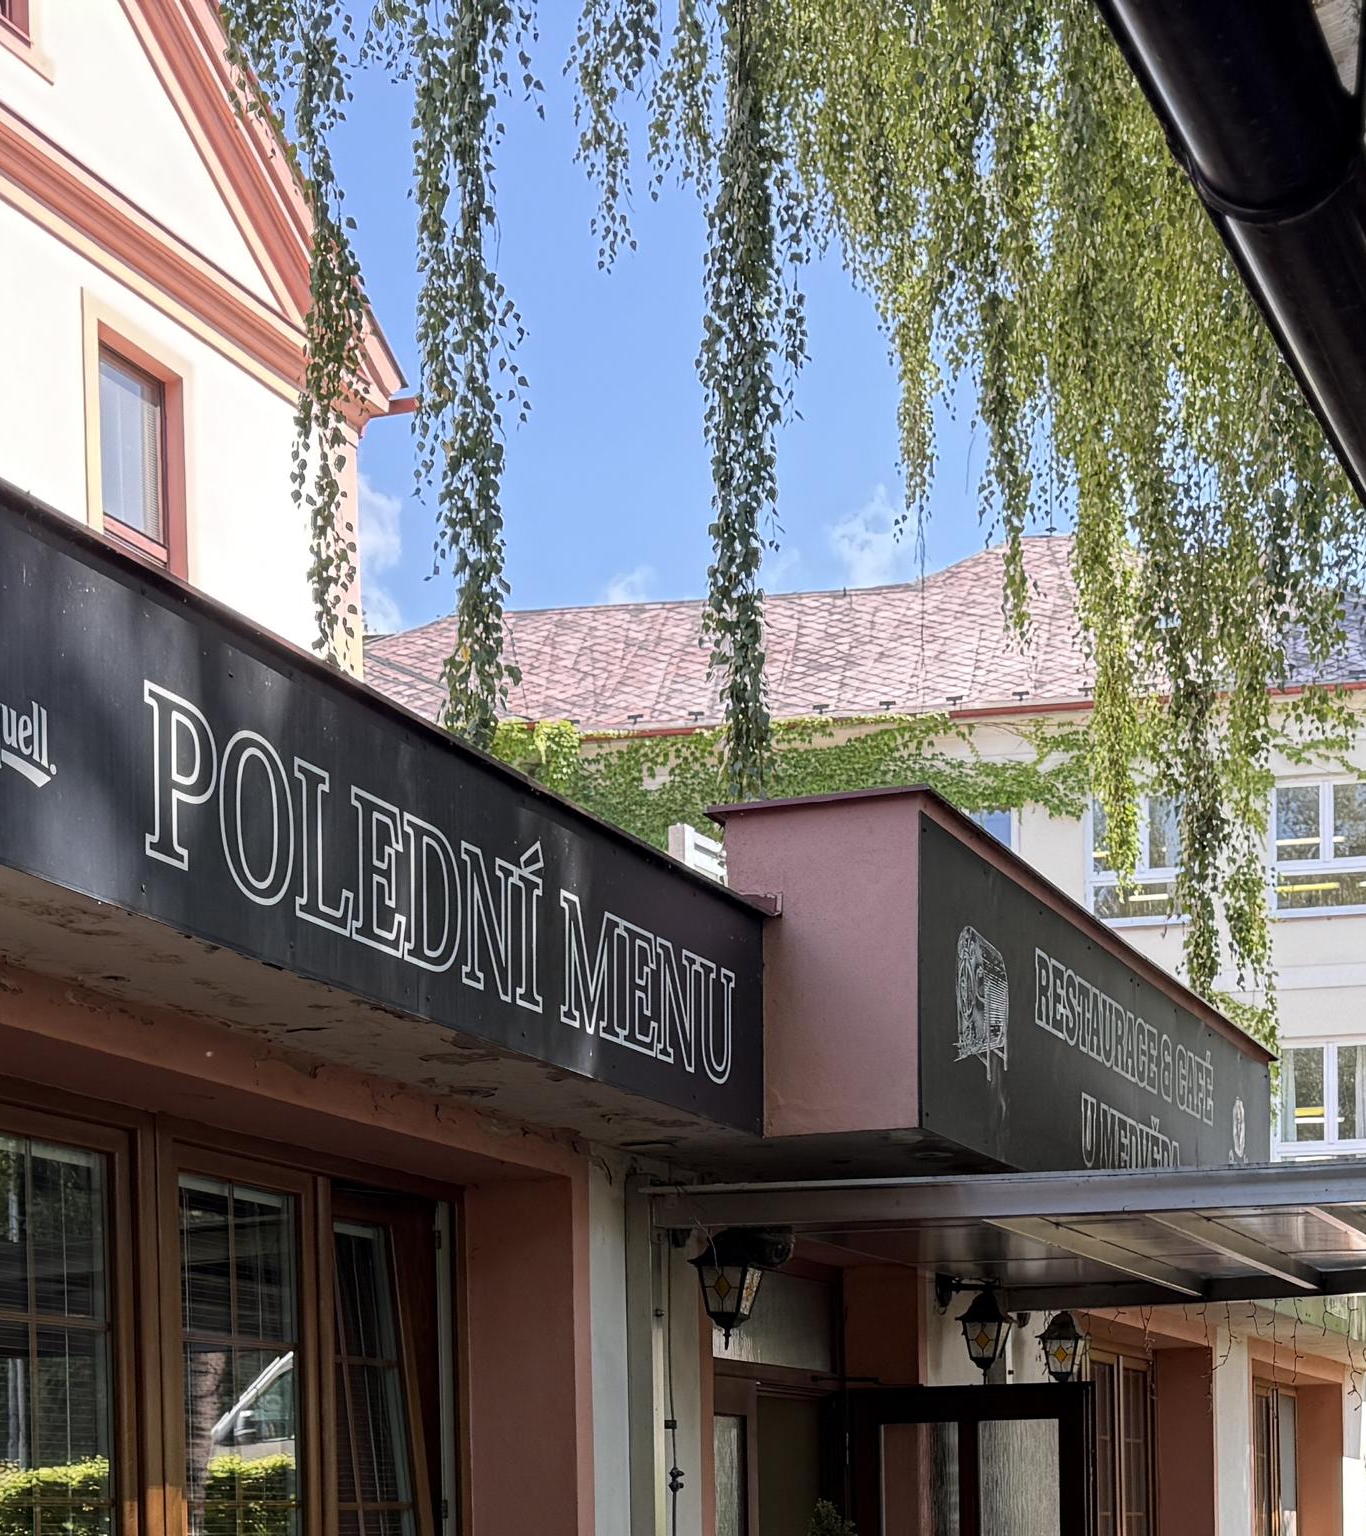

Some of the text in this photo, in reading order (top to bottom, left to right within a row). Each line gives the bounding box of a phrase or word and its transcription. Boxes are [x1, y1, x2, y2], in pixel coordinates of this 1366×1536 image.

[143, 679, 736, 1085] POLEDNÍ MENU
[1035, 947, 1214, 1127] RESTAURACE & CAFÉ
[1081, 1091, 1096, 1168] U
